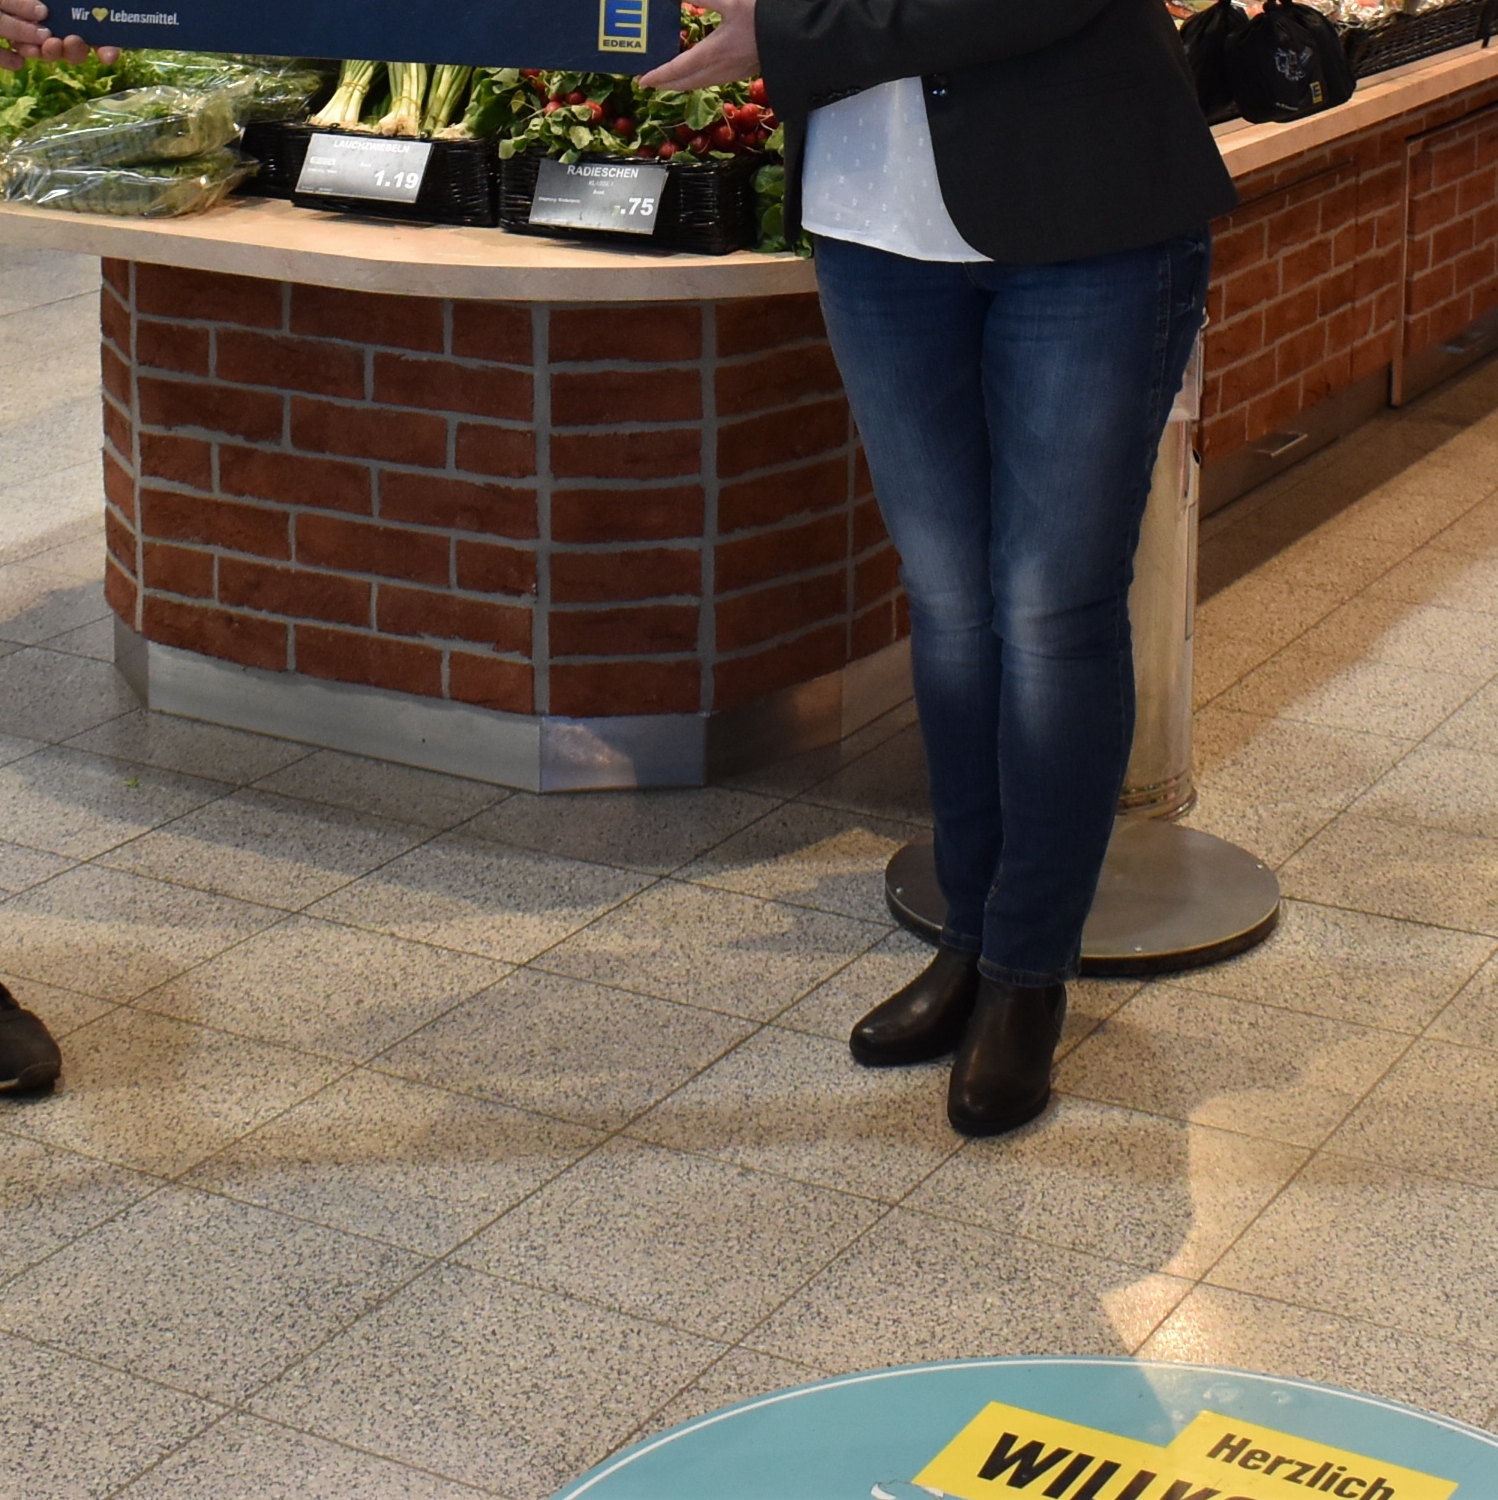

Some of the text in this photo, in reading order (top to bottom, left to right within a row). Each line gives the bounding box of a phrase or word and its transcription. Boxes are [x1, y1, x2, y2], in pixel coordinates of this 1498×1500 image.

[71, 7, 180, 26] Wir Lebensmittel.
[603, 40, 642, 49] EDEKA
[333, 140, 410, 153] LAUCHZWIEBELN
[374, 170, 419, 189] 1.19
[567, 165, 639, 179] RADIESCHEN
[976, 1431, 1261, 1500] WILLK
[1206, 1433, 1396, 1500] Herzlich
